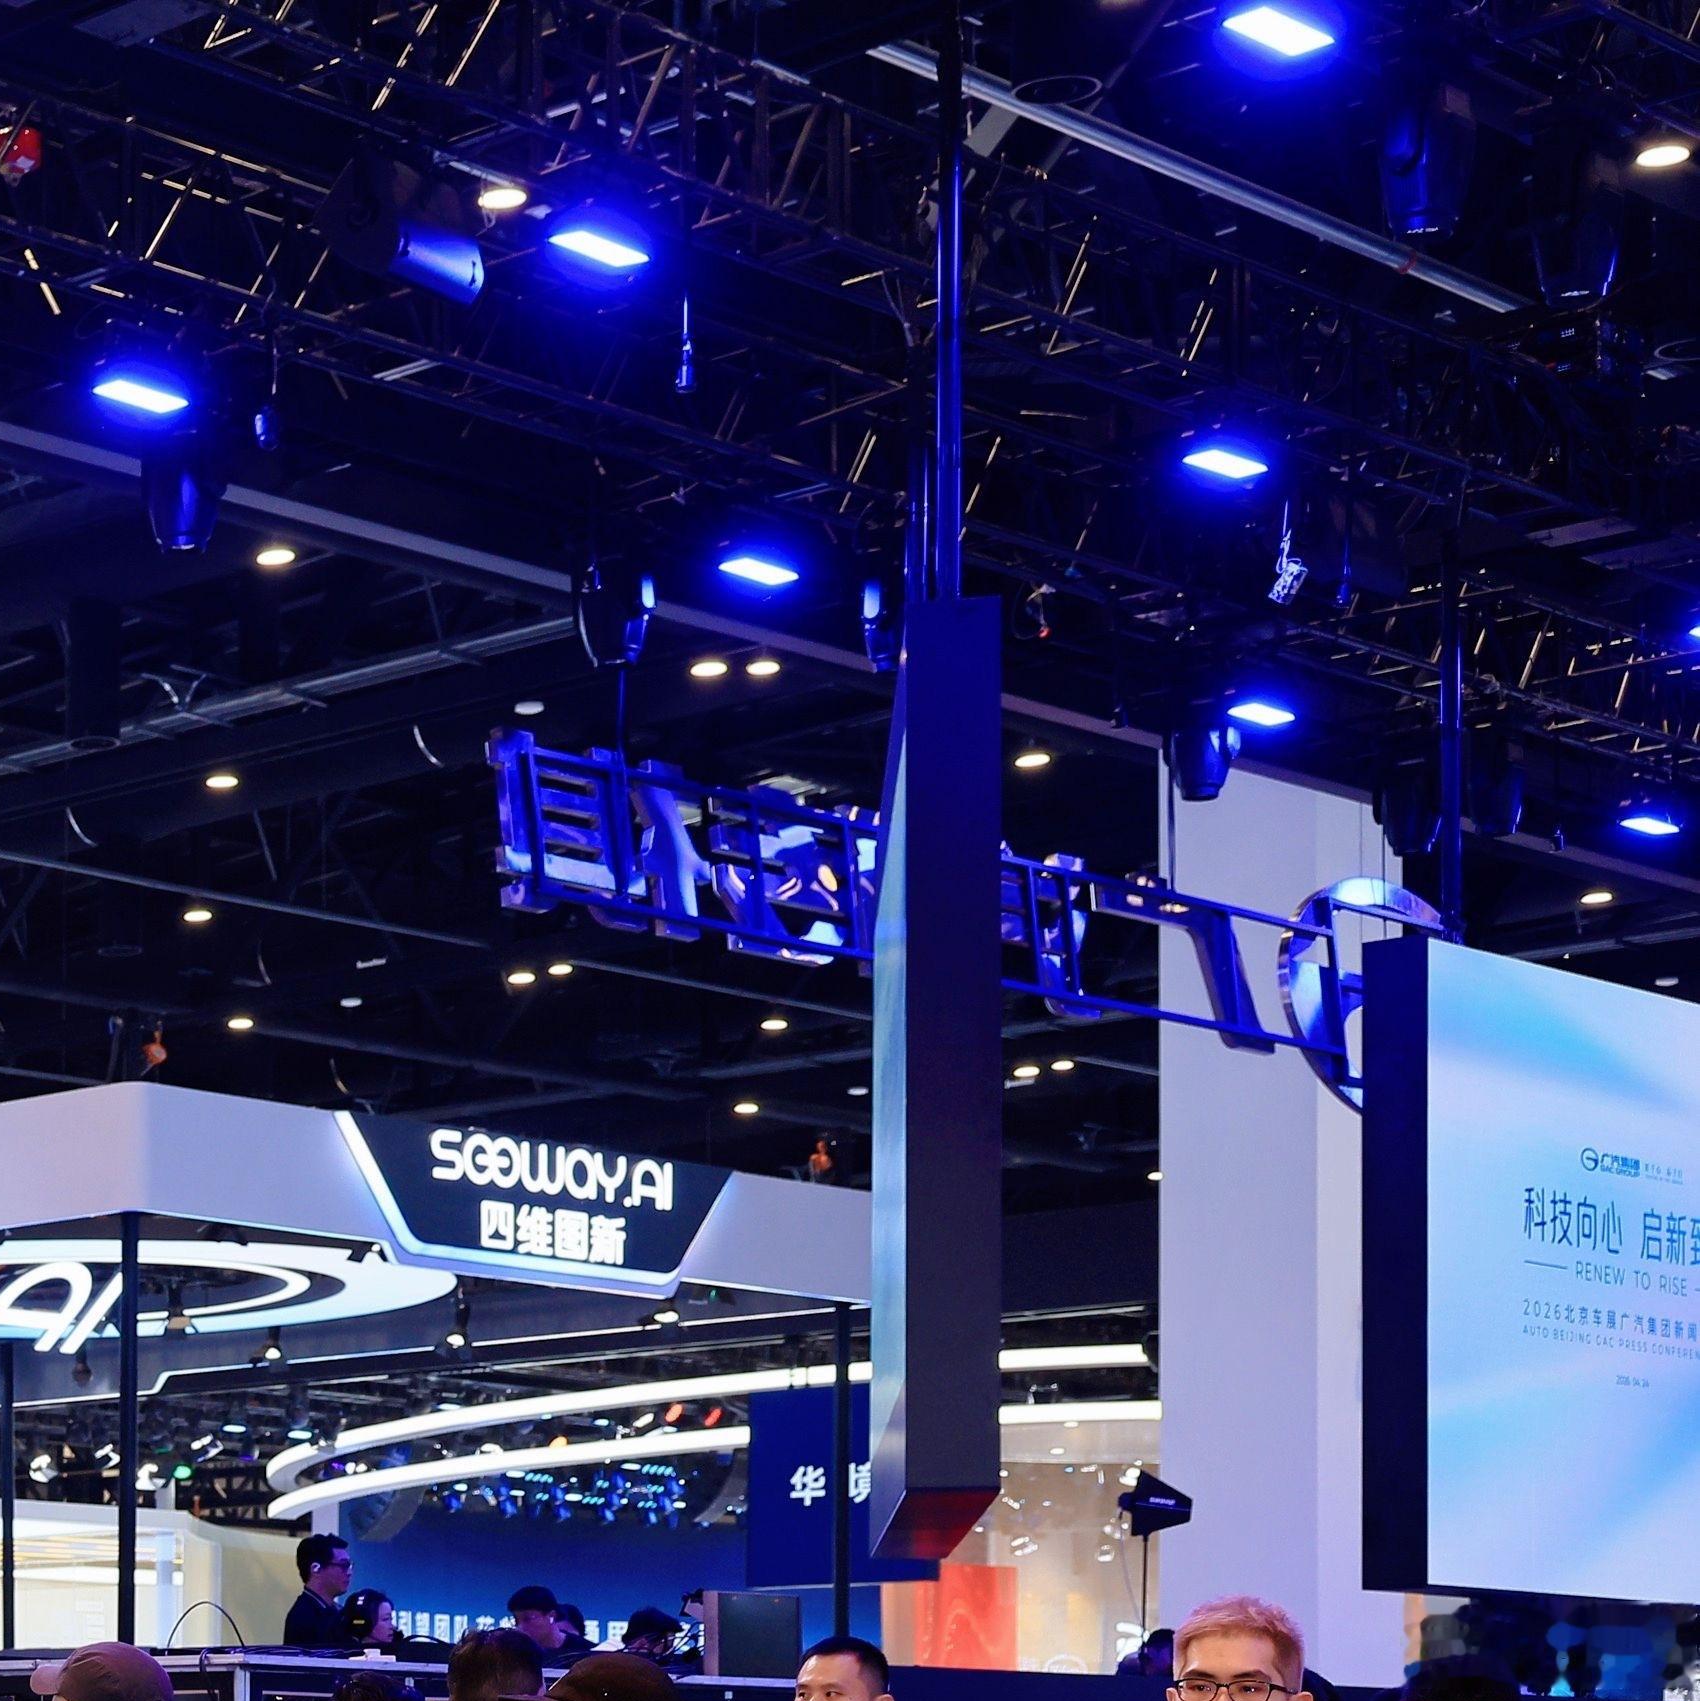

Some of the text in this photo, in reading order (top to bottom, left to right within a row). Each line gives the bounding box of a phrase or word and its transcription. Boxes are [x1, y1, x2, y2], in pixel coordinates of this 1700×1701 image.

[479, 1199, 628, 1265] 四维图新
[1523, 1187, 1623, 1255] 科技向心
[1575, 1260, 1688, 1297] RENEW TO RISE
[1522, 1324, 1550, 1339] AUTO
[1552, 1328, 1592, 1346] BEIJING
[1618, 1339, 1648, 1353] PRESS
